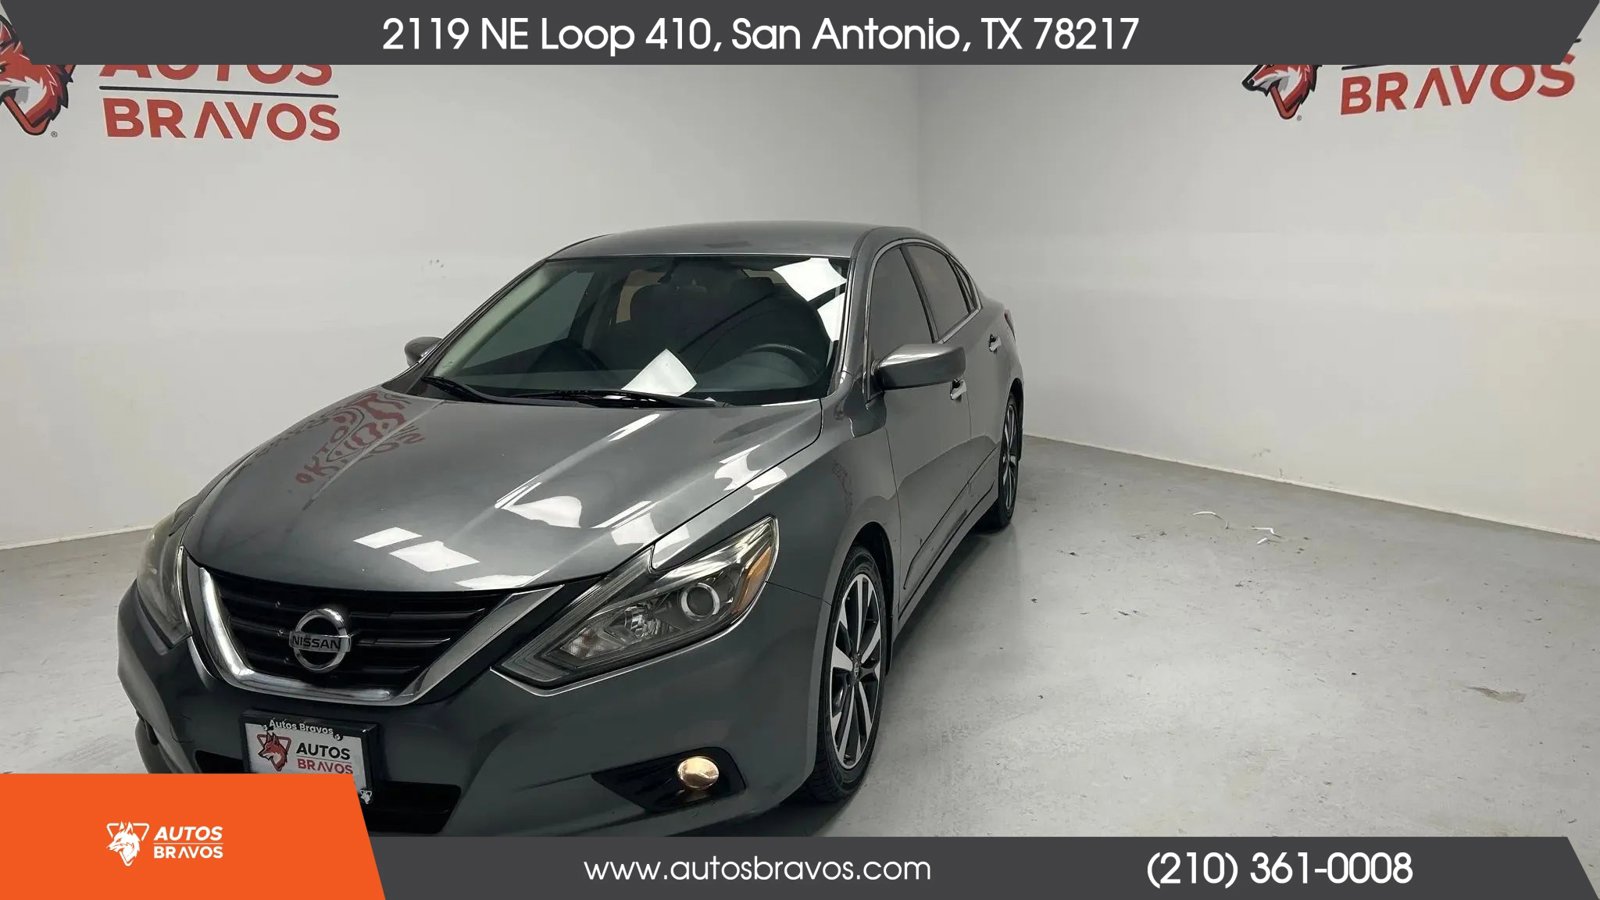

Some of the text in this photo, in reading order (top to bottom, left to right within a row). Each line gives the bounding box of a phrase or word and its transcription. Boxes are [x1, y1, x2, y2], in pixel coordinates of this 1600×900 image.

[1341, 54, 1574, 115] BRAVOS
[104, 98, 339, 141] BRAVOS
[292, 635, 341, 649] NISSAN
[269, 718, 334, 735] Autos Bravos
[296, 742, 351, 760] AUTOS
[297, 758, 353, 774] BRAVOS
